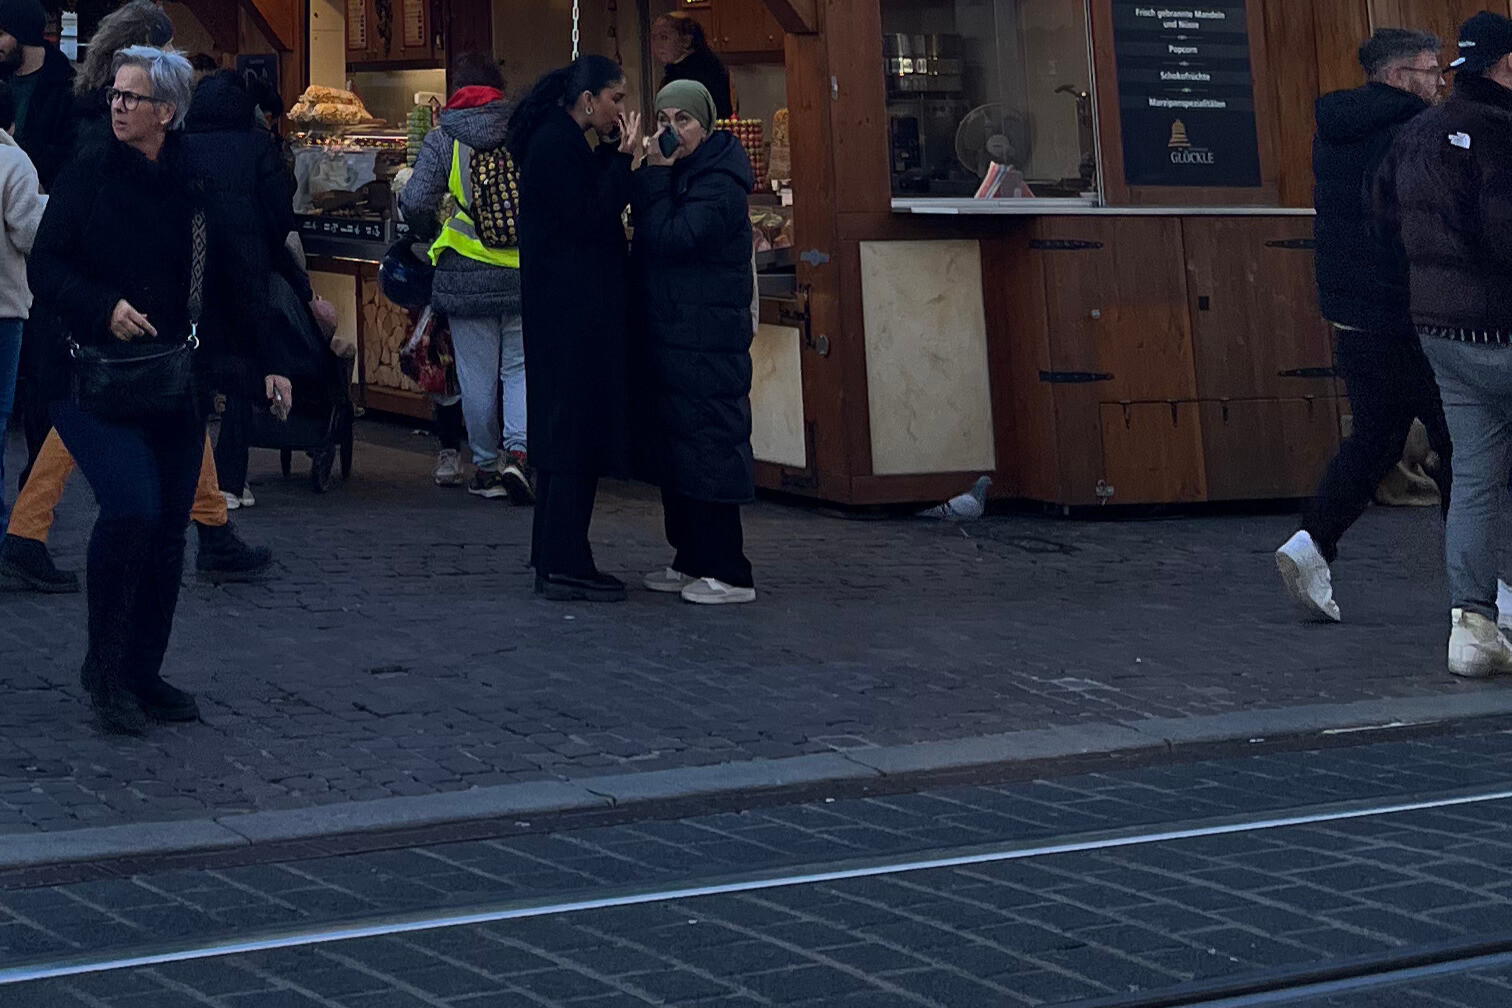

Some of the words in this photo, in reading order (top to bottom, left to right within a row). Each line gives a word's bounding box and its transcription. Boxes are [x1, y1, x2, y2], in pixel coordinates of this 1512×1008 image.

[1135, 7, 1156, 17] Frisch
[1157, 9, 1193, 20] gebrannte
[1194, 10, 1225, 20] Mandeln
[1163, 20, 1177, 29] und
[1168, 44, 1198, 55] Popcorn
[1160, 71, 1211, 82] Schokofrüchte
[1149, 97, 1226, 109] Marzipanspezialitäten
[1170, 149, 1215, 164] GLÖCKLE
